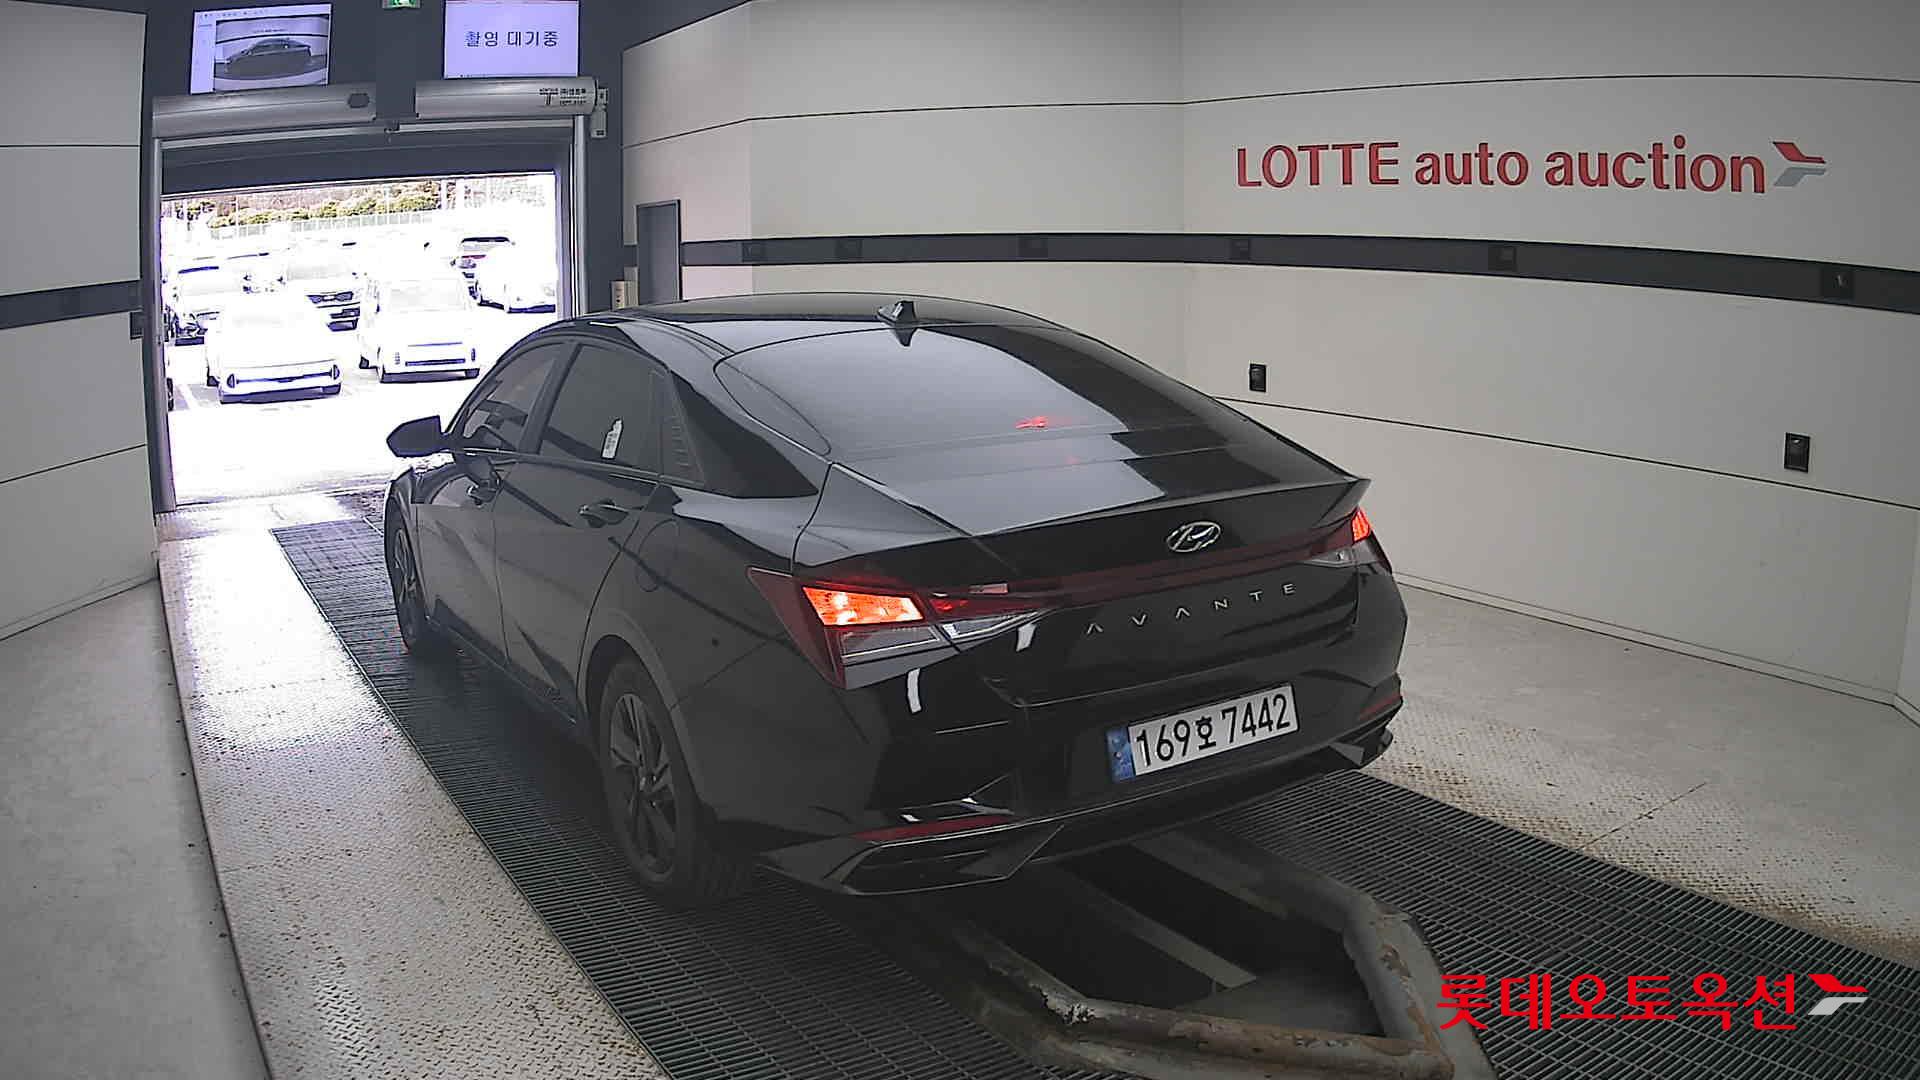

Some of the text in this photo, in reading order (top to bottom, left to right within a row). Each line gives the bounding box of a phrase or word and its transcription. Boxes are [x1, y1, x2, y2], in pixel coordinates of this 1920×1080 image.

[507, 31, 558, 47] 대기중
[1237, 135, 1766, 193] LOTTE auto auction
[1086, 583, 1296, 635] AVANTE
[1221, 694, 1291, 744] 7442
